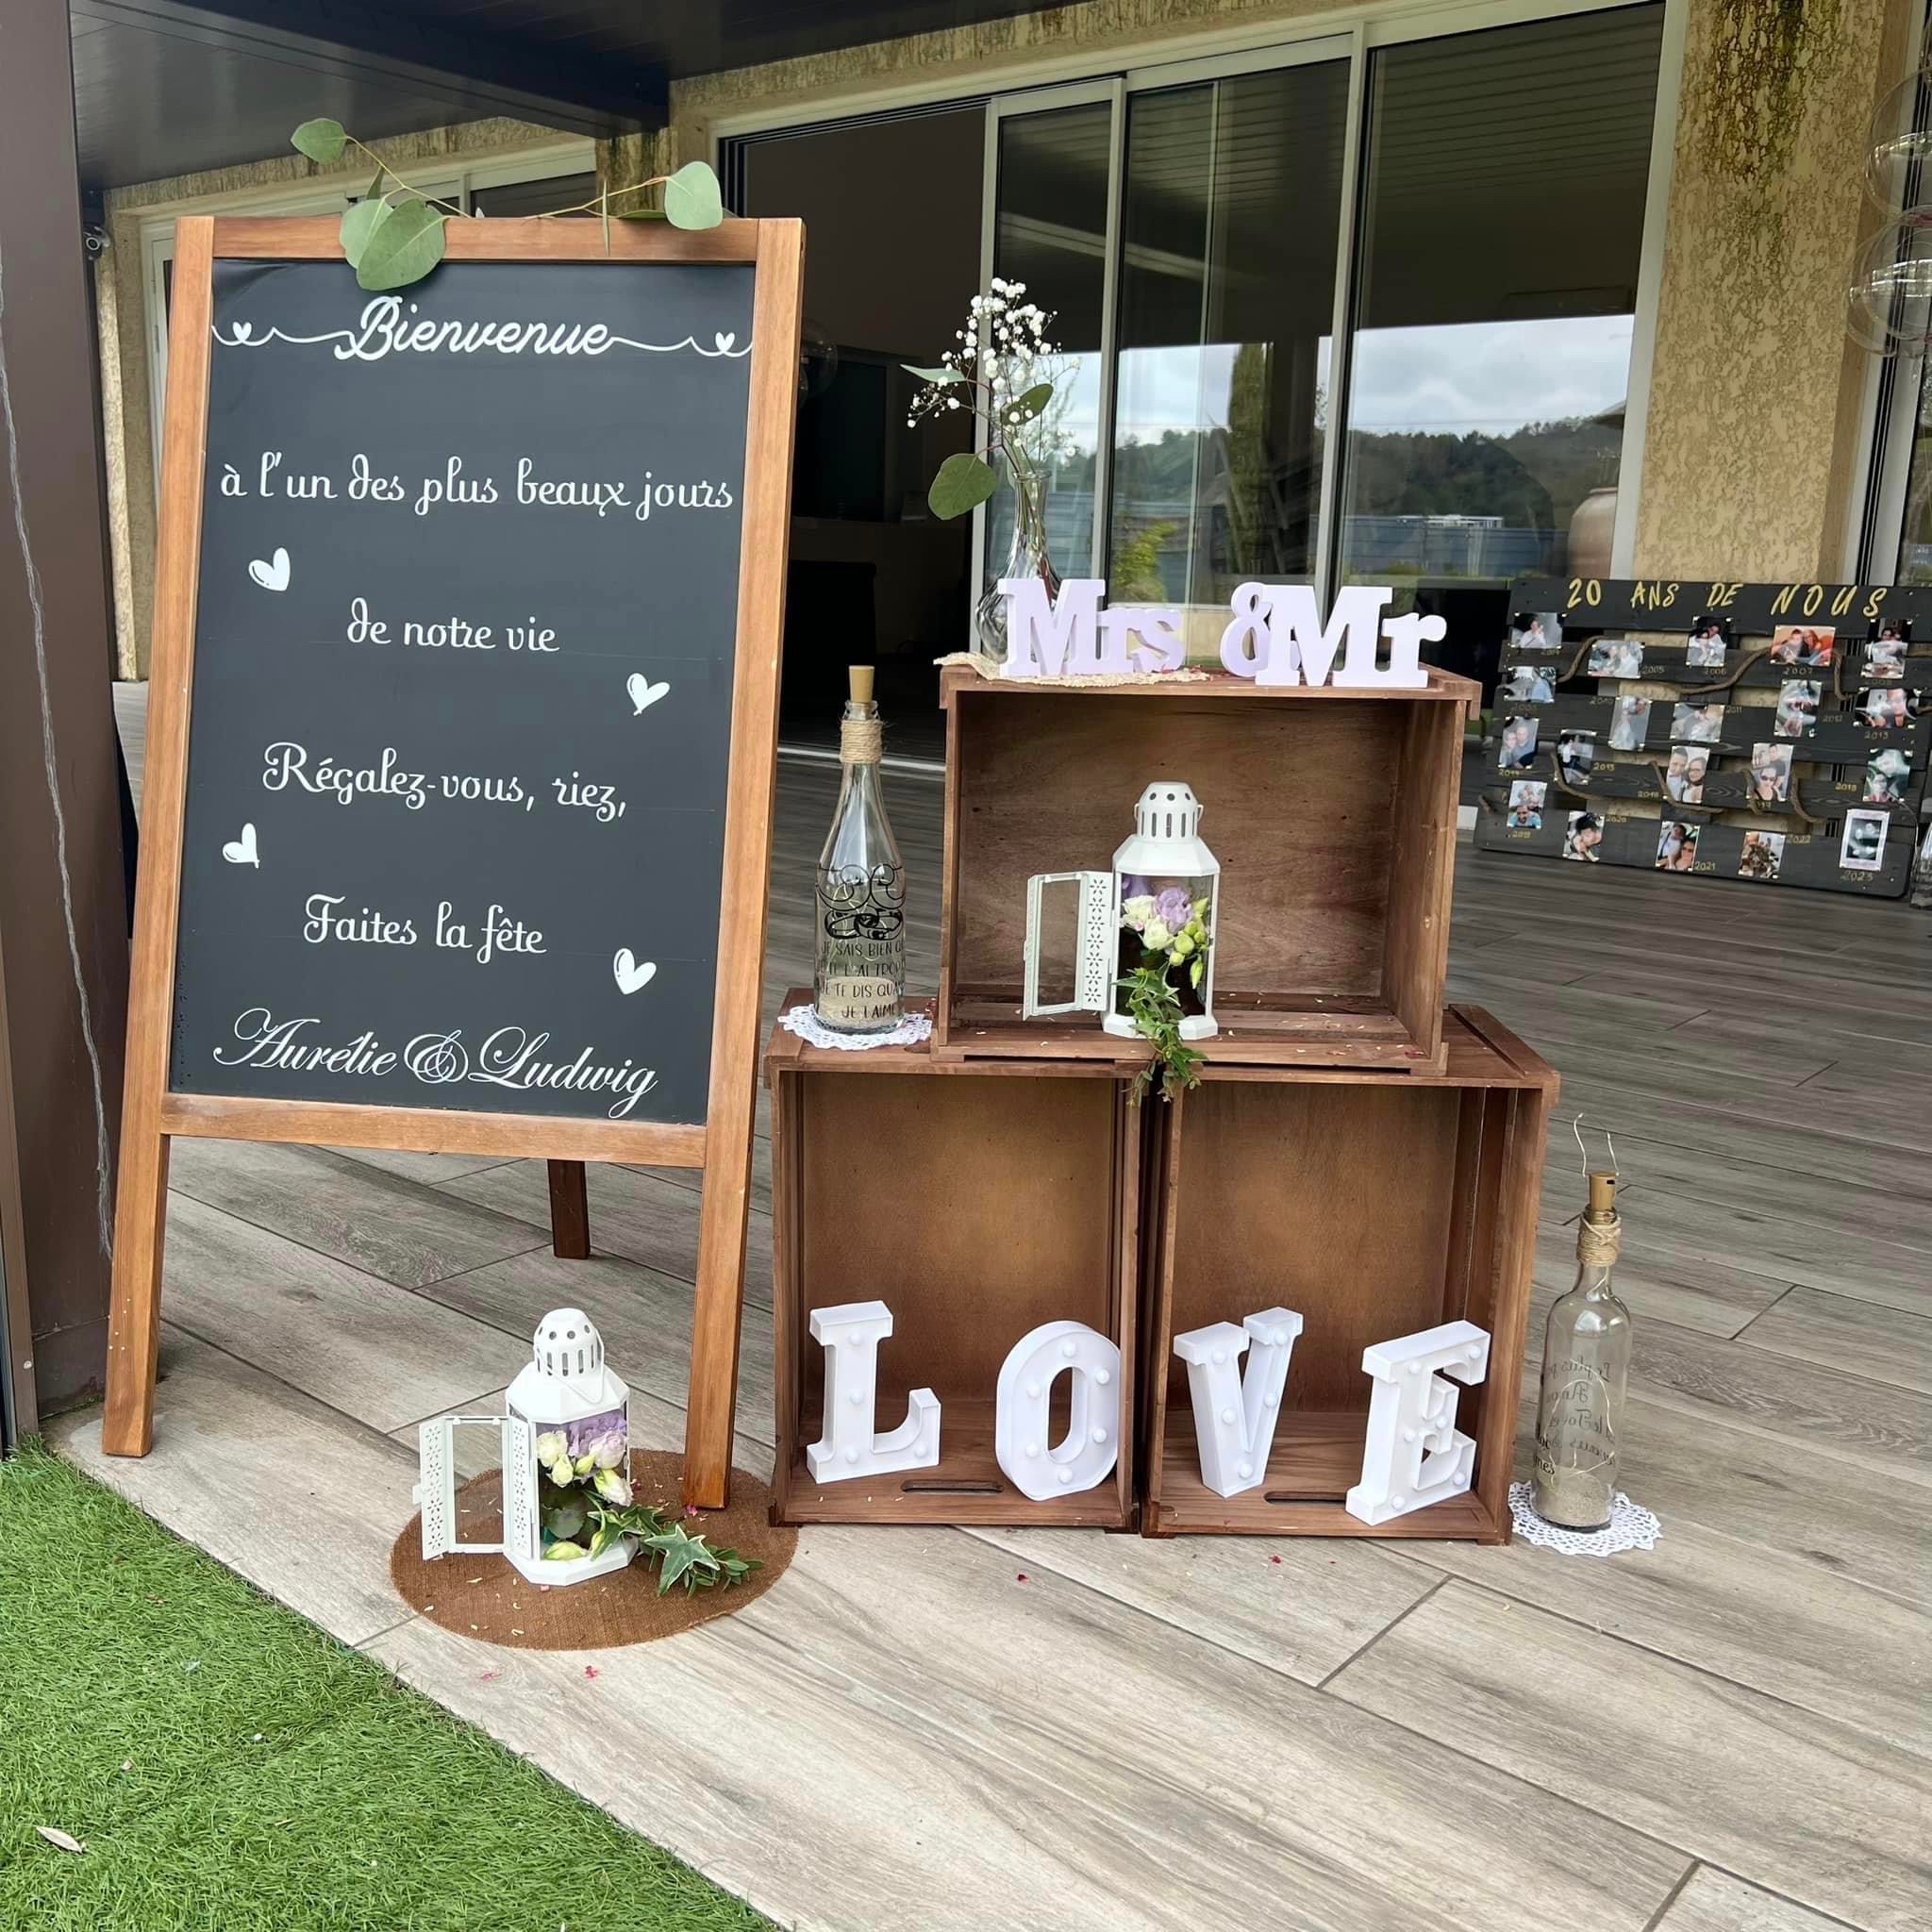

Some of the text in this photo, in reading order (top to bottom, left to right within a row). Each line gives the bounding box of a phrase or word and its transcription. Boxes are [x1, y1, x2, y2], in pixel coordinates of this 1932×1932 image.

[335, 295, 615, 361] Bienvenue
[220, 463, 248, 497] à
[347, 453, 406, 502] des
[414, 456, 499, 516] plus
[516, 458, 631, 518] beaux
[635, 471, 734, 522] jours
[346, 596, 560, 653] de notre vie
[997, 578, 1186, 678] Mrs
[1566, 578, 1888, 617] 20 ANS DE NOUS
[262, 741, 627, 823] Régalez-vous, riez,
[303, 893, 548, 964] Faites la fête
[835, 942, 863, 957] SAIS
[868, 941, 893, 957] BIEN
[853, 984, 873, 998] DIS
[212, 1007, 659, 1120] Aurélie & Ludwig
[807, 1300, 1491, 1526] LOVE
